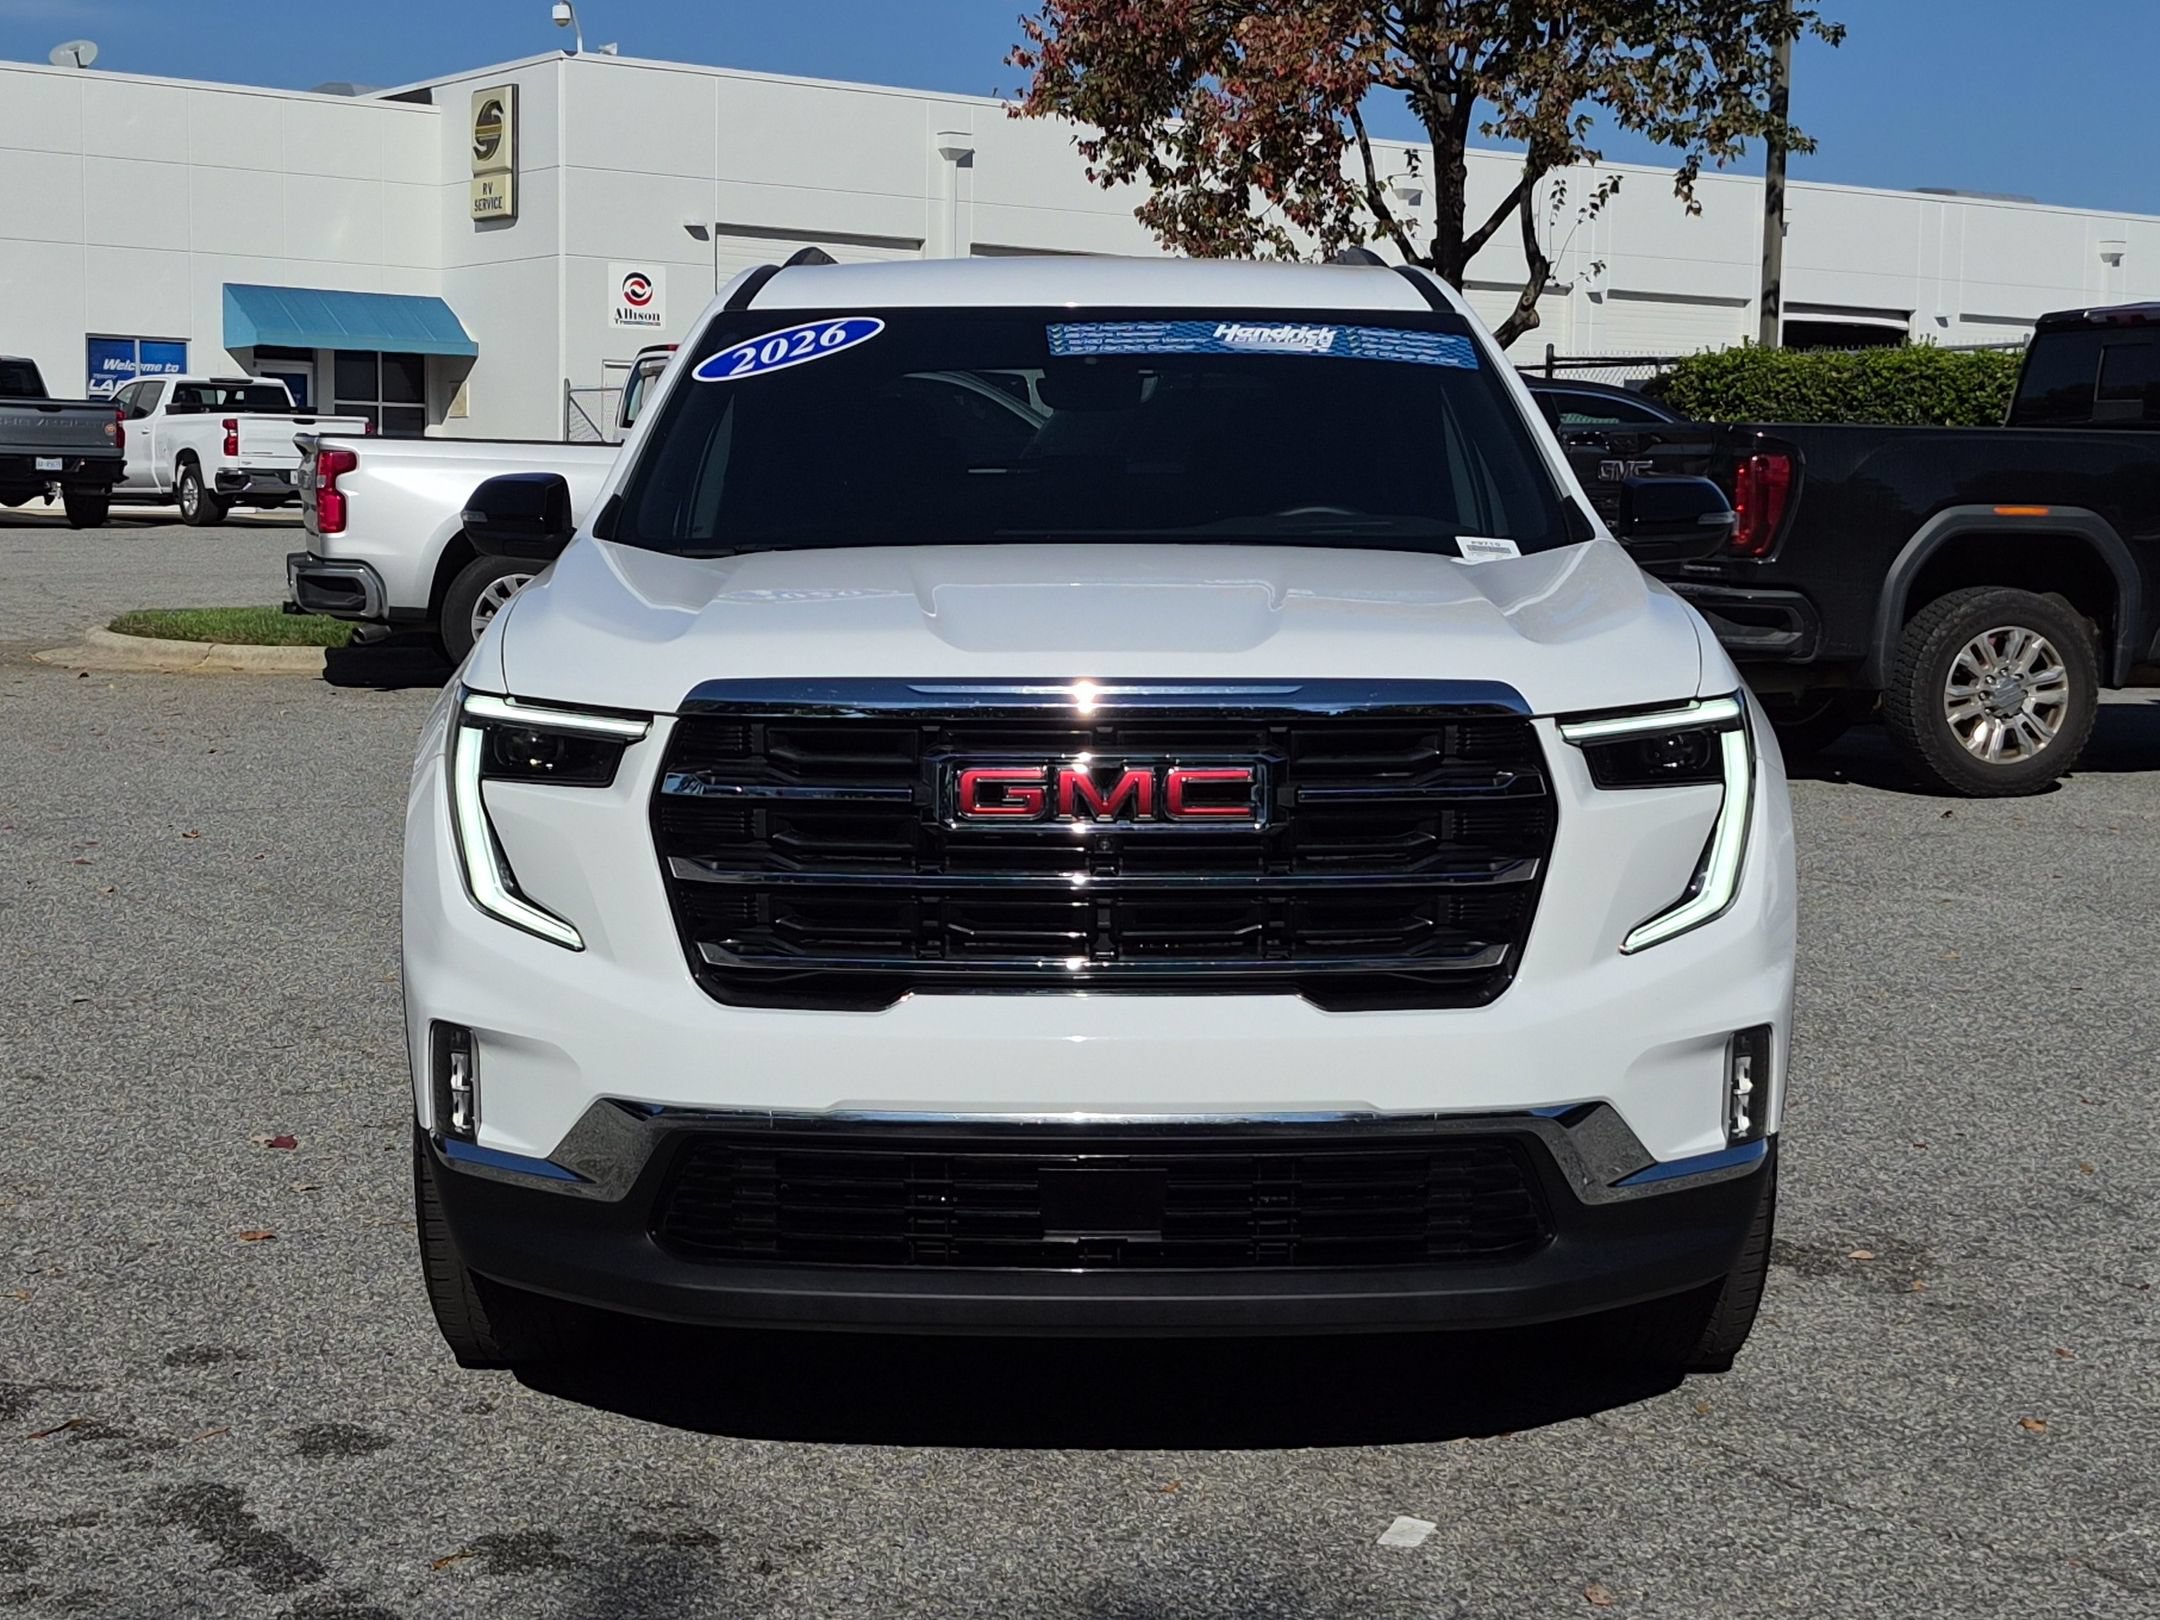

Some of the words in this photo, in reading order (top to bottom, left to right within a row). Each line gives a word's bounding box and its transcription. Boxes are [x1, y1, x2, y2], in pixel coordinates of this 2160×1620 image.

[482, 181, 494, 196] RV
[473, 195, 504, 212] SERVICE
[614, 307, 661, 321] Allison
[1213, 323, 1337, 348] Hendrick
[729, 320, 848, 376] 2026
[164, 362, 179, 373] to
[957, 766, 1256, 822] GMC
